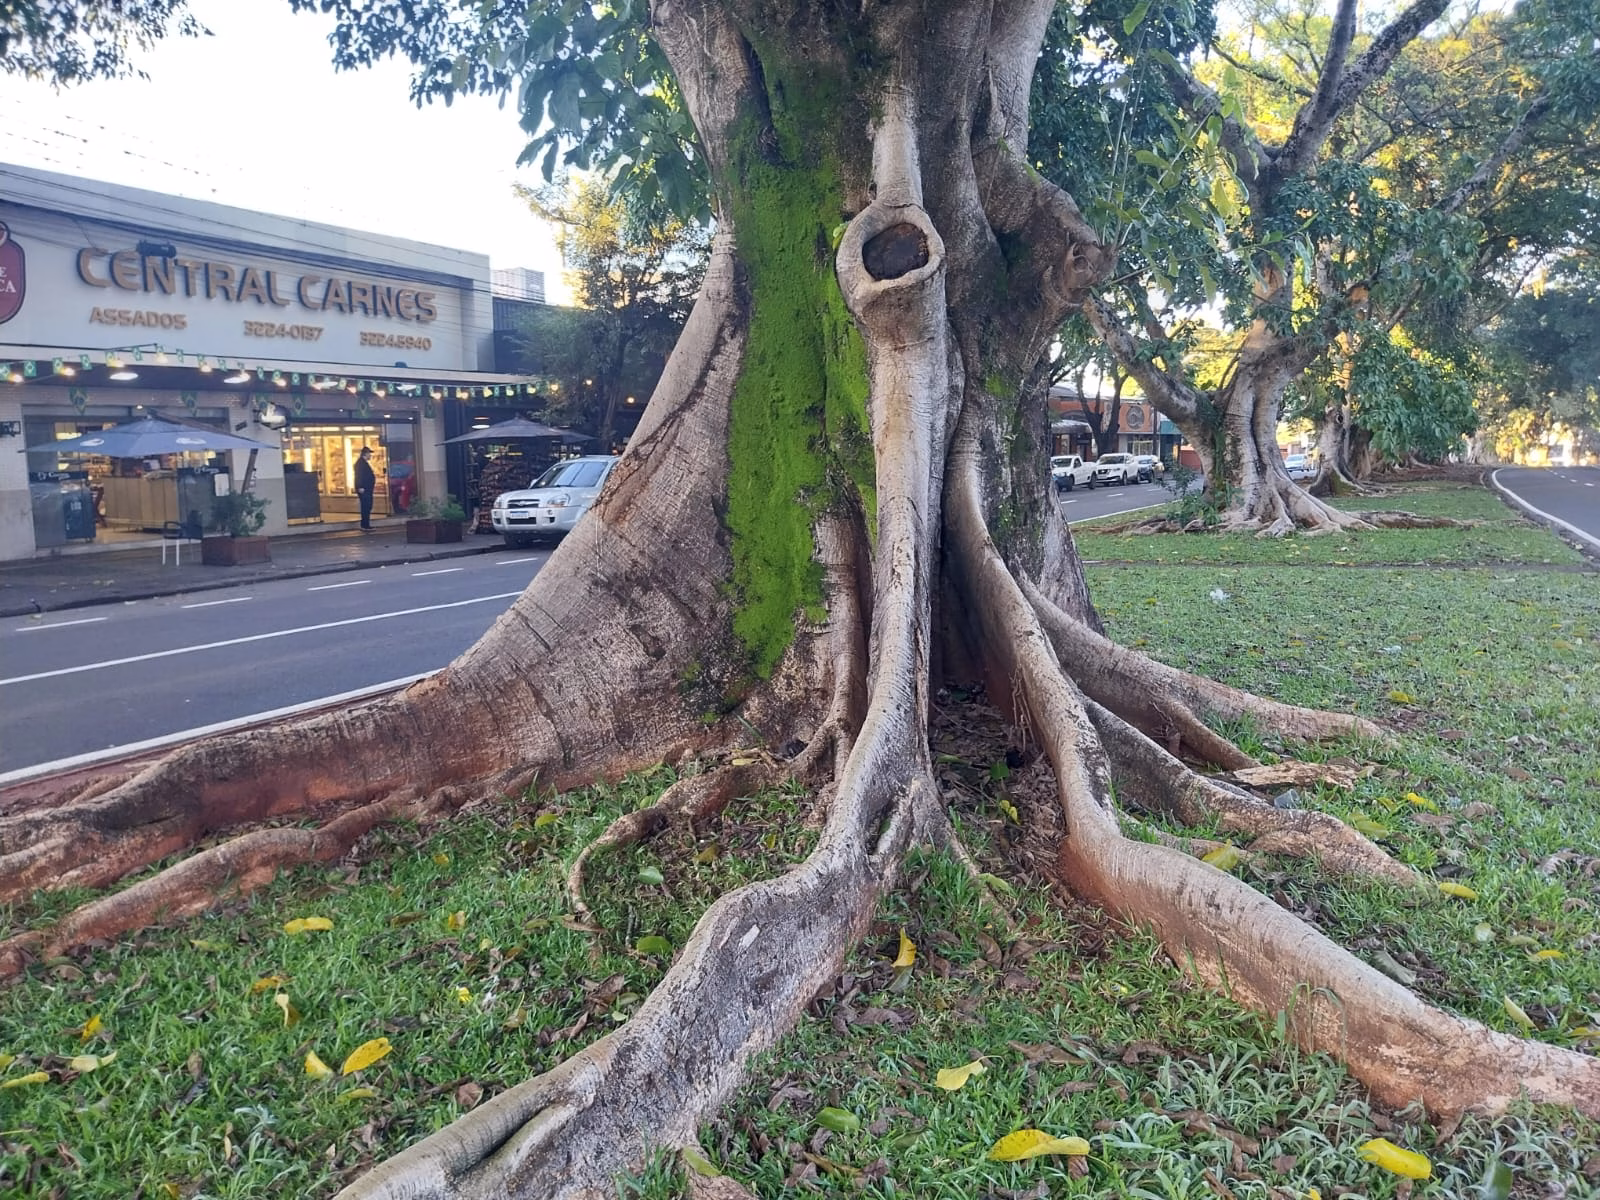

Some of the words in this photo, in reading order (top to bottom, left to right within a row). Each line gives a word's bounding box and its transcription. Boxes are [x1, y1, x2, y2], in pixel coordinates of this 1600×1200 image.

[77, 247, 290, 306] CENTRAL
[297, 275, 437, 323] CARNES
[89, 306, 188, 330] ASSADOS
